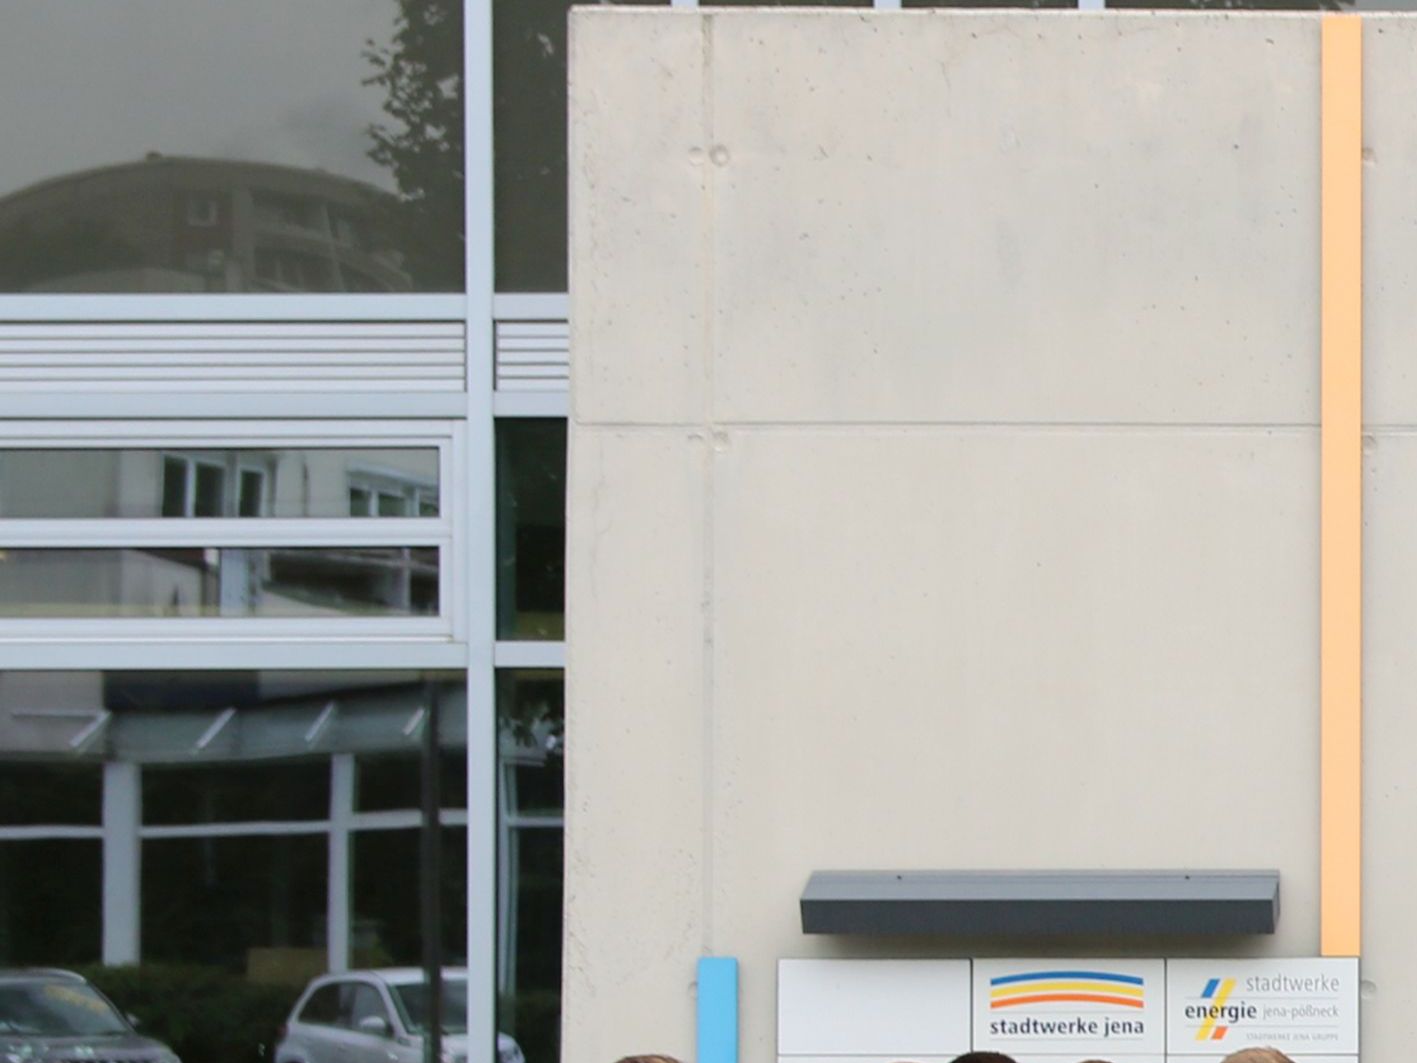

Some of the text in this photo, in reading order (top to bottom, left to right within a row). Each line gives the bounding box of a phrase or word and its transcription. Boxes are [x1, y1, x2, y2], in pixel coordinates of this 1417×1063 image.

[1245, 973, 1340, 992] stadtwerke
[1184, 1001, 1257, 1024] energie
[990, 1017, 1144, 1038] stadtwerke jena
